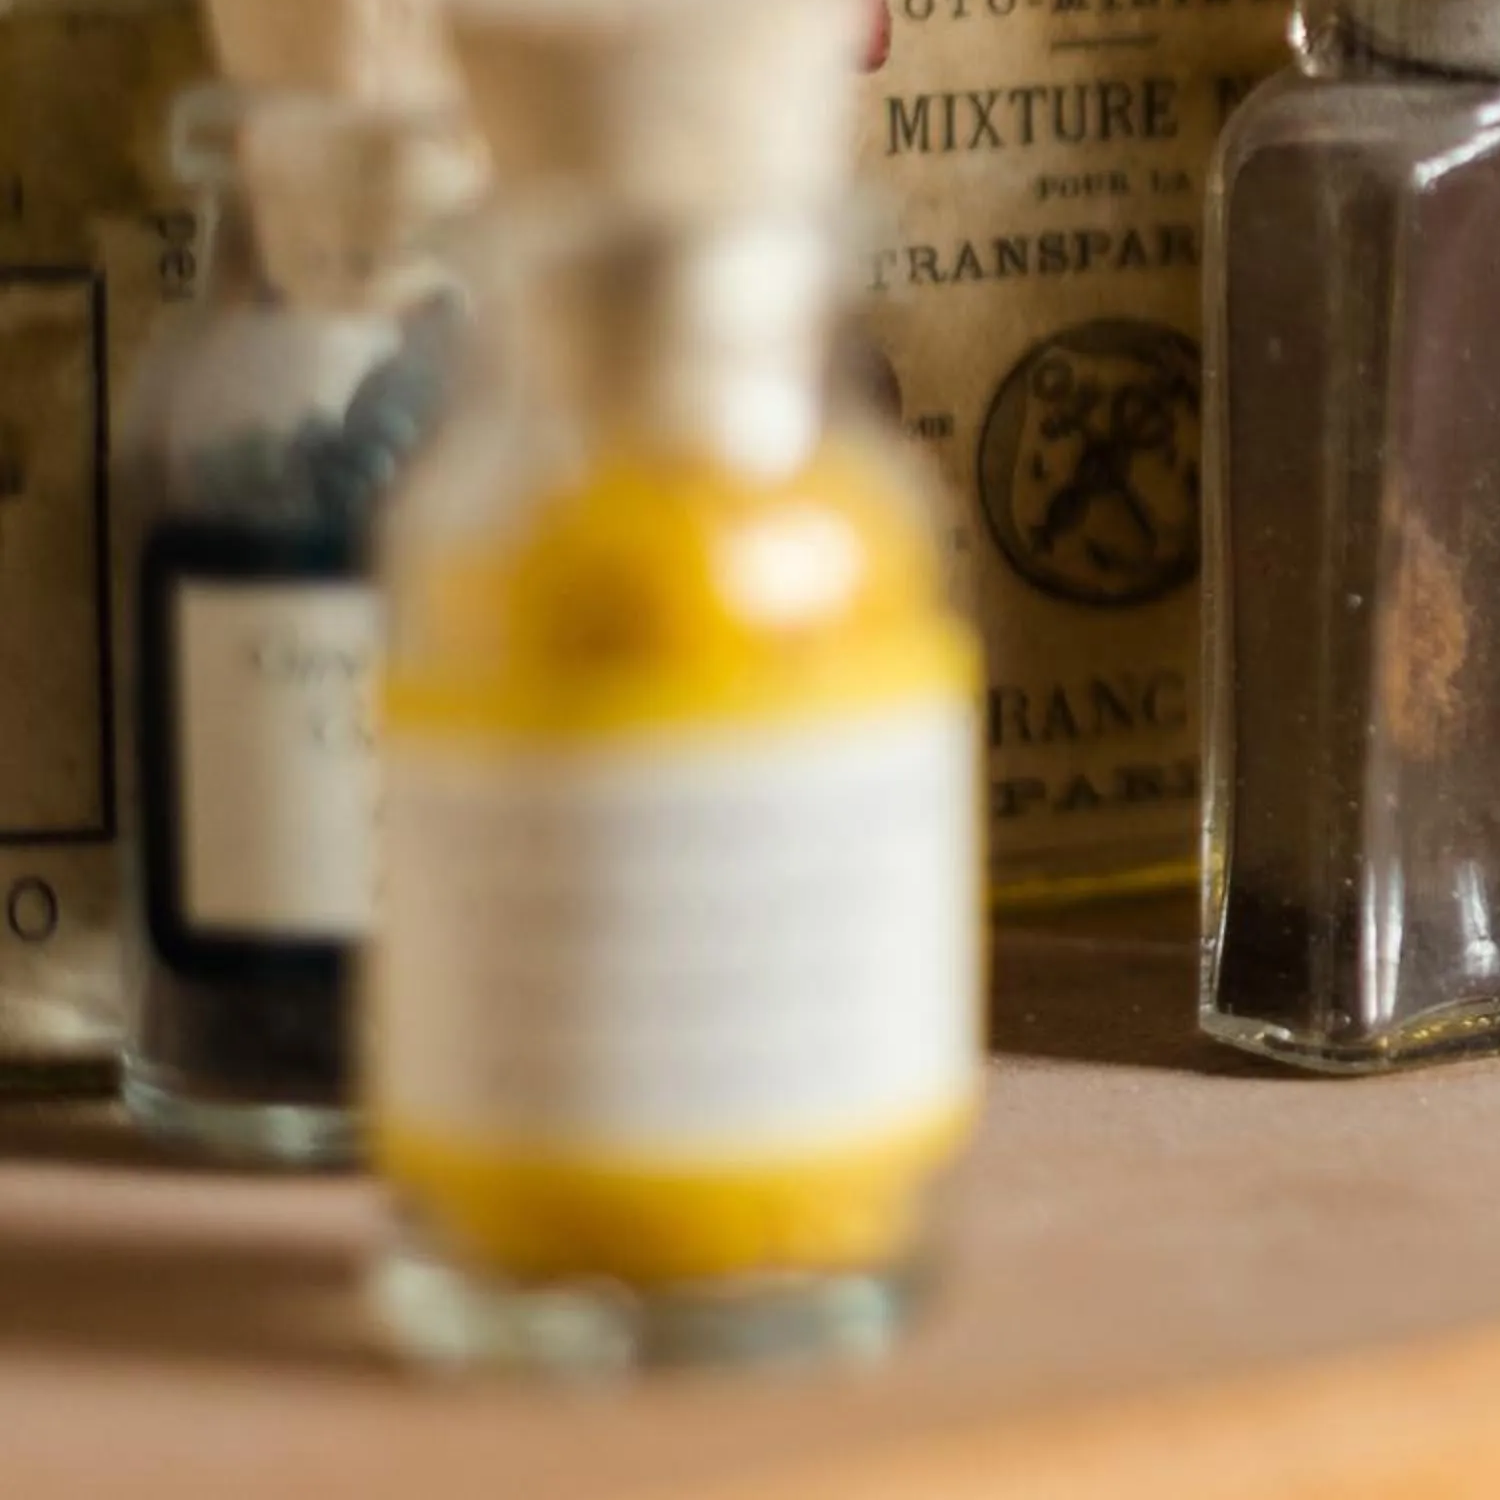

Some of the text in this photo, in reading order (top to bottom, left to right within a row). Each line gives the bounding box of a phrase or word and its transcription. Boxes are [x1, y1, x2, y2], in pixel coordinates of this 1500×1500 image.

[885, 75, 1179, 158] MIXTURE
[1035, 170, 1131, 201] POUR
[867, 225, 1199, 292] TRANSPAR
